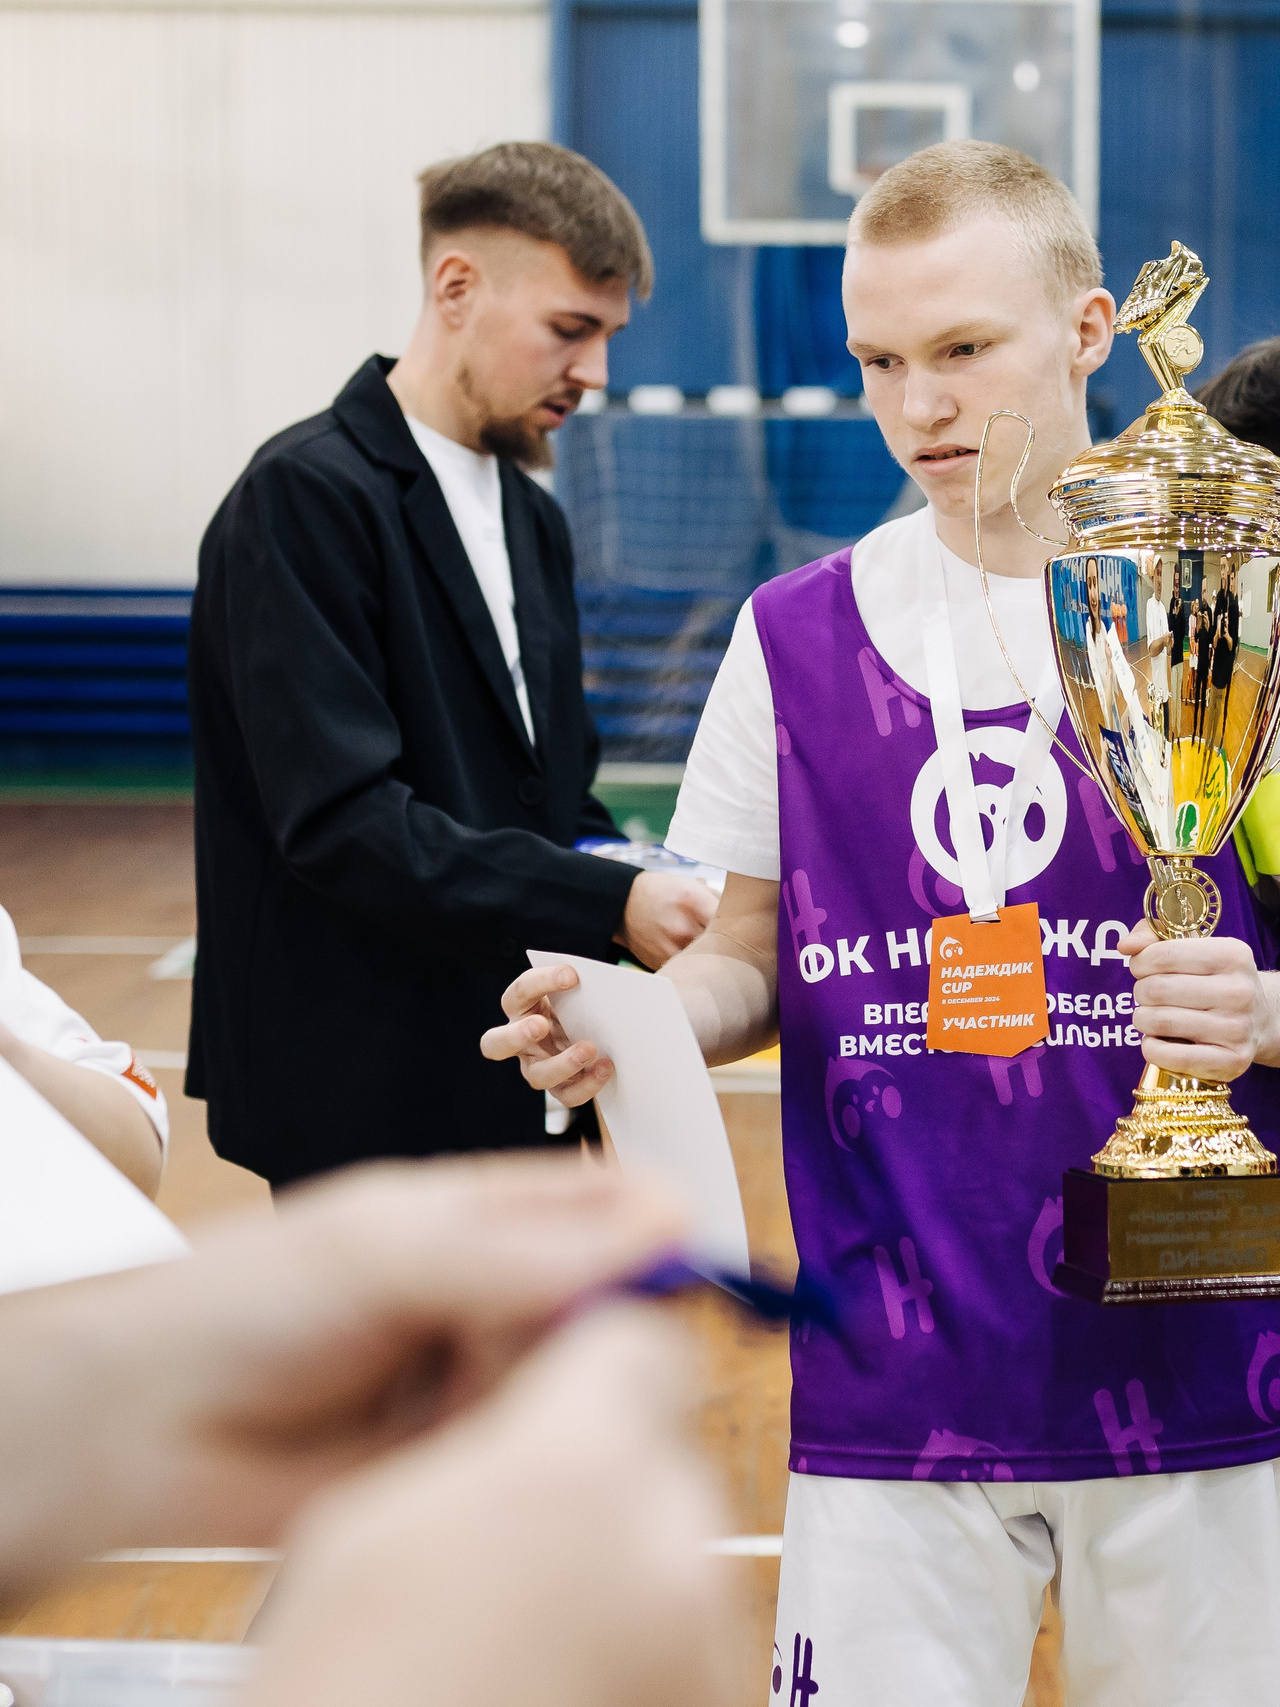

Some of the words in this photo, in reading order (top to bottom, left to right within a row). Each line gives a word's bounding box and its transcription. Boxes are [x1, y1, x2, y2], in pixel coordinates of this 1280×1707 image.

[941, 962, 1034, 979] НАДЕЖДИК
[942, 982, 973, 994] CUP
[1046, 992, 1140, 1019] ОБЕДЕ
[942, 1013, 1035, 1031] УЧАСТНИК
